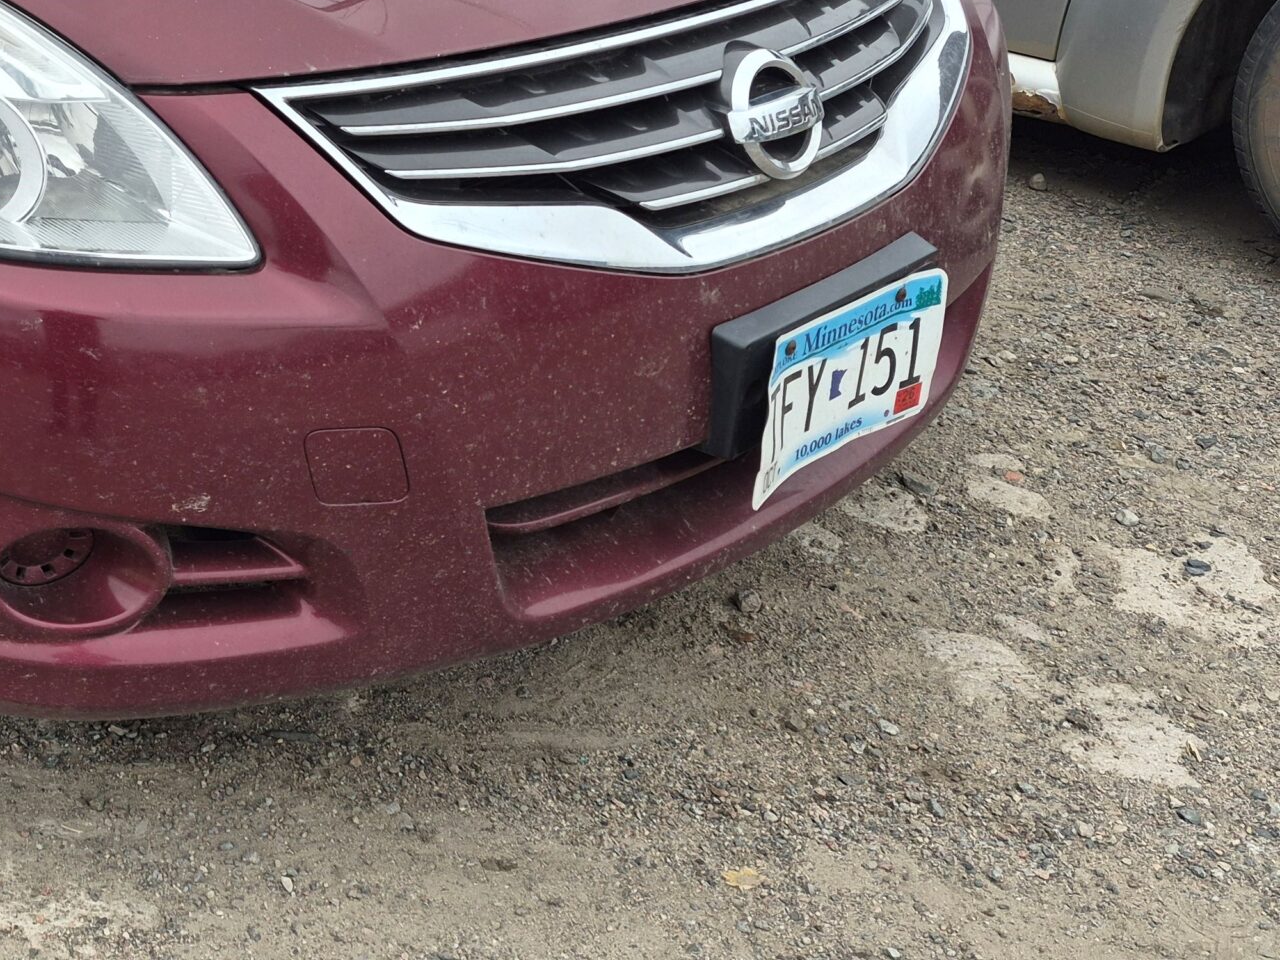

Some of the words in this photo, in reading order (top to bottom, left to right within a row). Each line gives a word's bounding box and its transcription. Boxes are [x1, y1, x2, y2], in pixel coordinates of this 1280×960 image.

[749, 91, 823, 138] NISSAN
[802, 297, 913, 357] Minnesota.com
[847, 317, 922, 410] 151
[794, 432, 832, 462] 10,000
[834, 416, 862, 440] lakes
